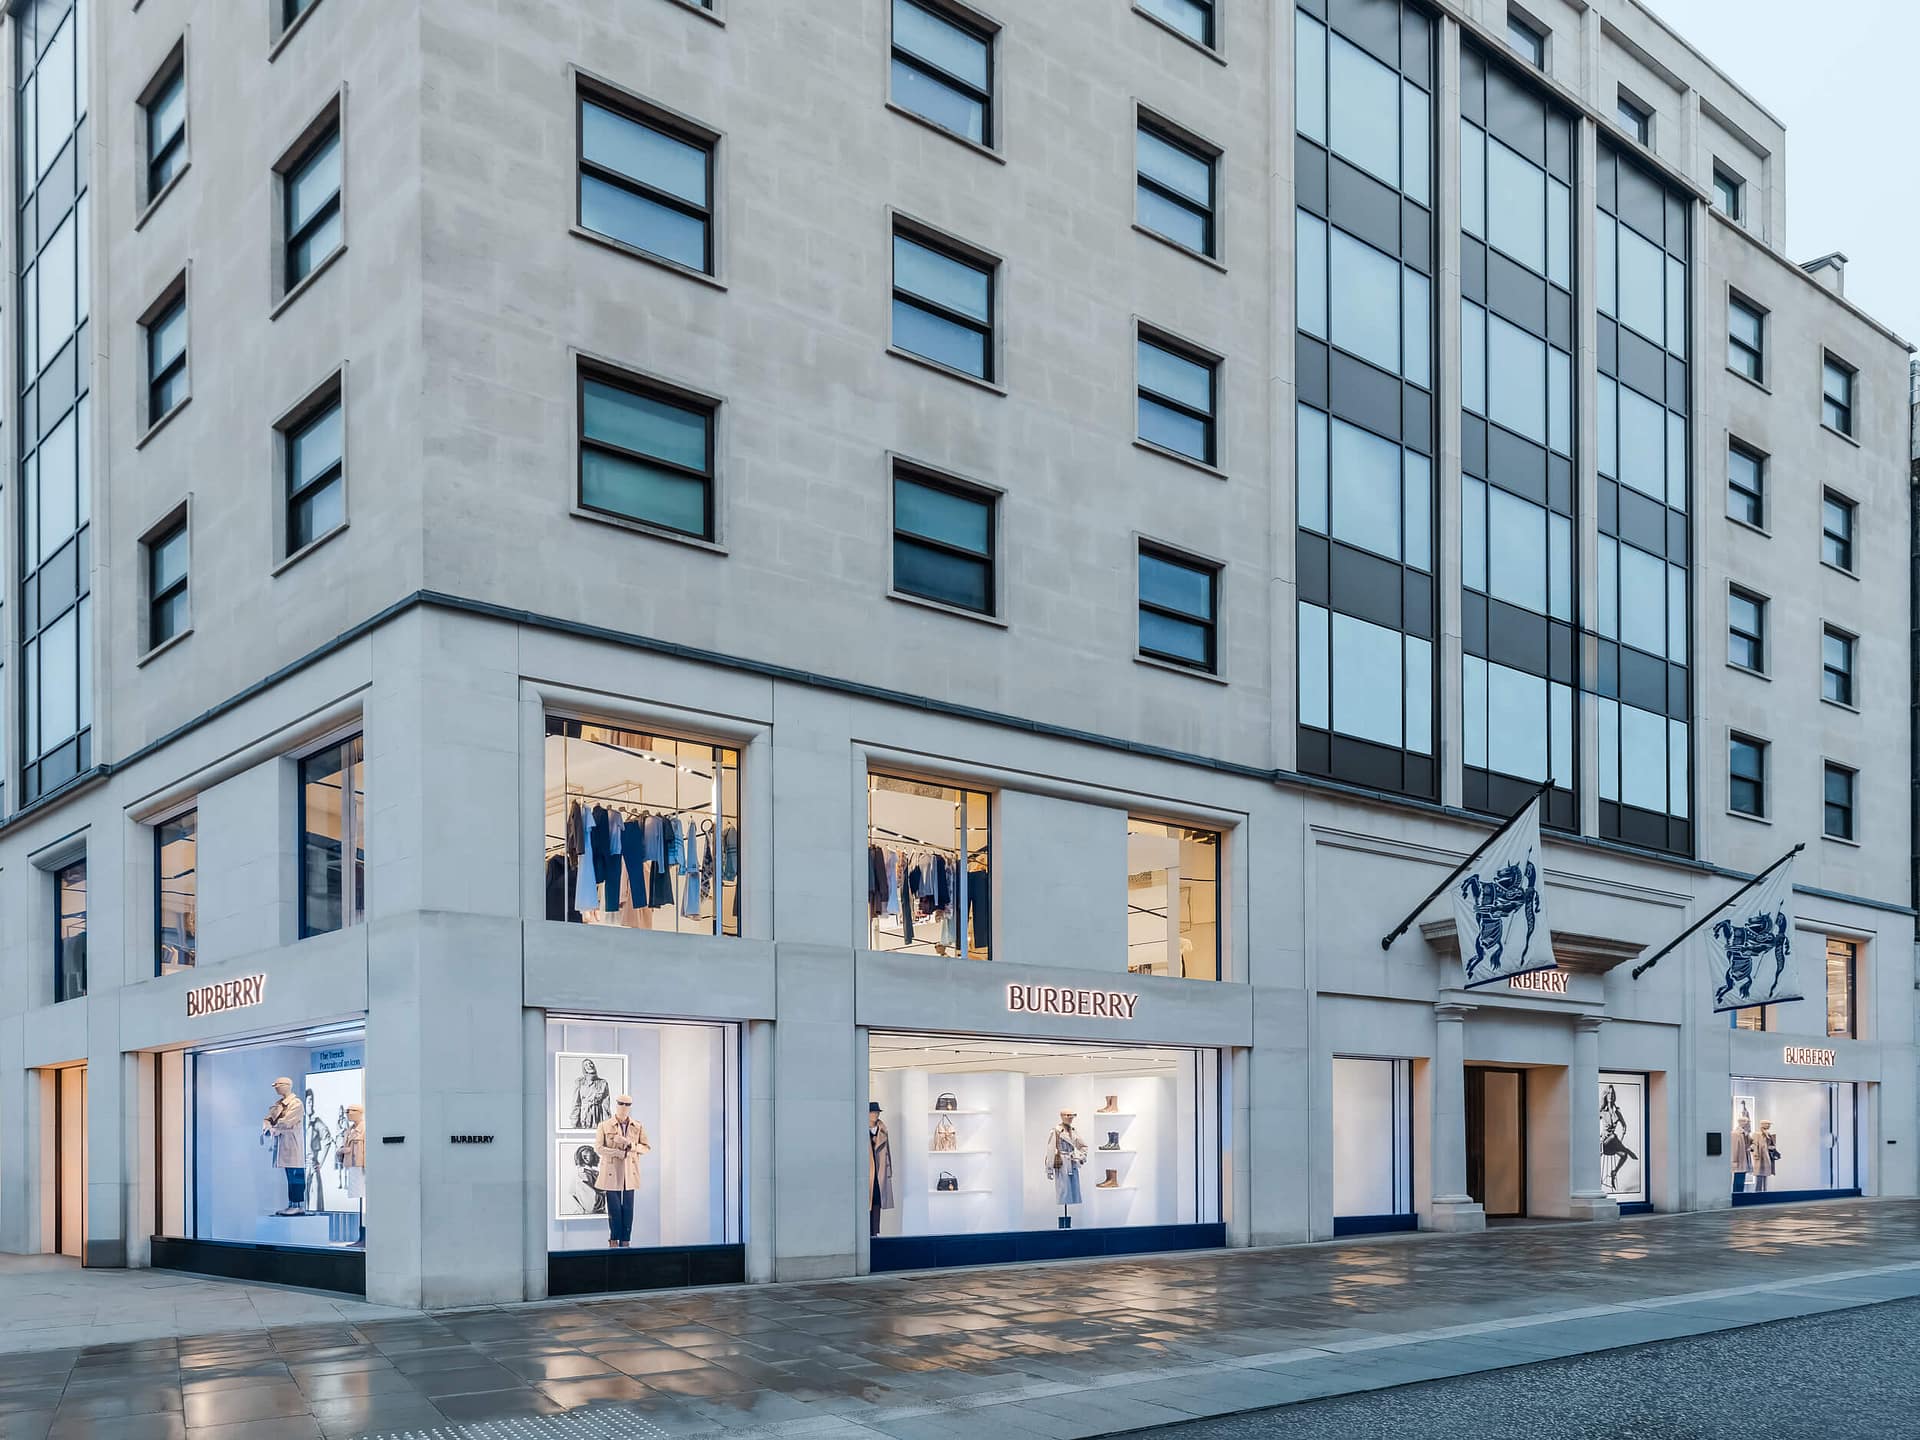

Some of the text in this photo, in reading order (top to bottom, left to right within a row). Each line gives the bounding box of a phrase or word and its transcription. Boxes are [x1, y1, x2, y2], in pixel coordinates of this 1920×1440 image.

[186, 973, 265, 1017] BURBERRY
[1008, 984, 1139, 1018] BURBERRY
[1785, 1047, 1837, 1066] BURBERRY
[450, 1135, 495, 1144] BURBERRY
